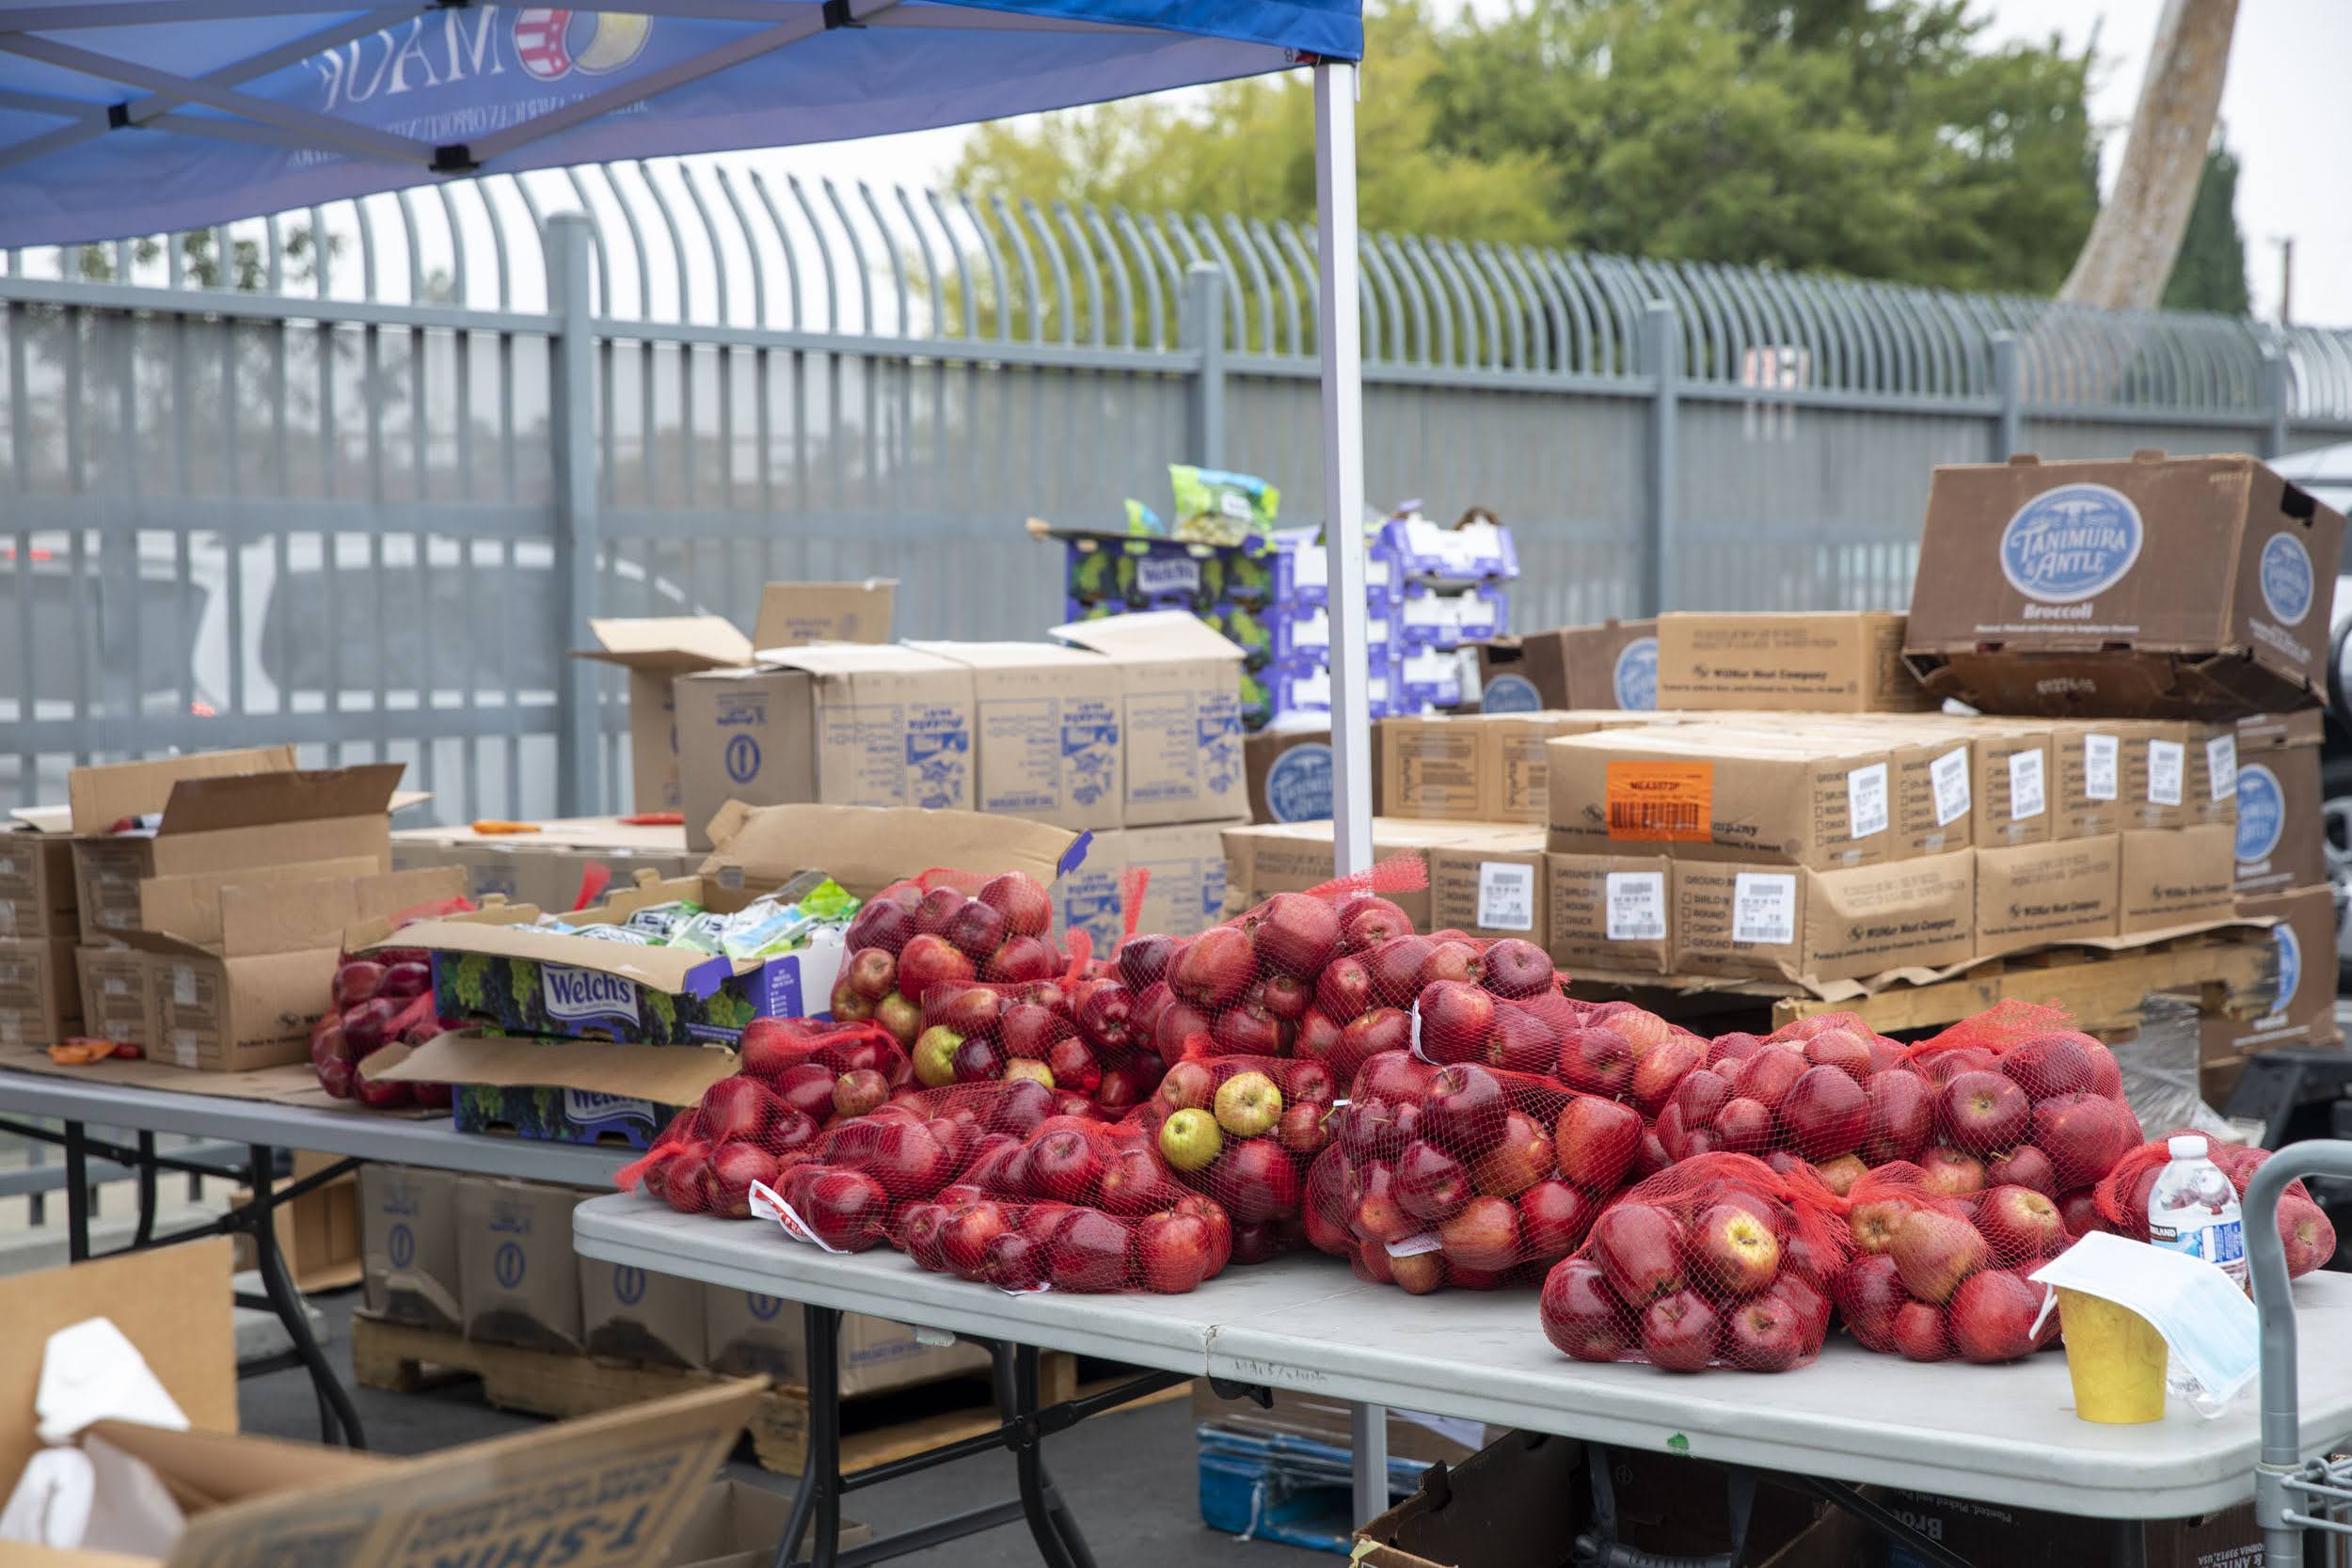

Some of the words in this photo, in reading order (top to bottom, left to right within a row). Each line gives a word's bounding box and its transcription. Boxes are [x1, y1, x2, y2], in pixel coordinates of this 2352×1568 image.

[2010, 523, 2126, 562] TANIMURA
[2028, 550, 2107, 585] ANTLE
[548, 972, 631, 1005] Welch's
[2198, 1555, 2212, 1565] USA
